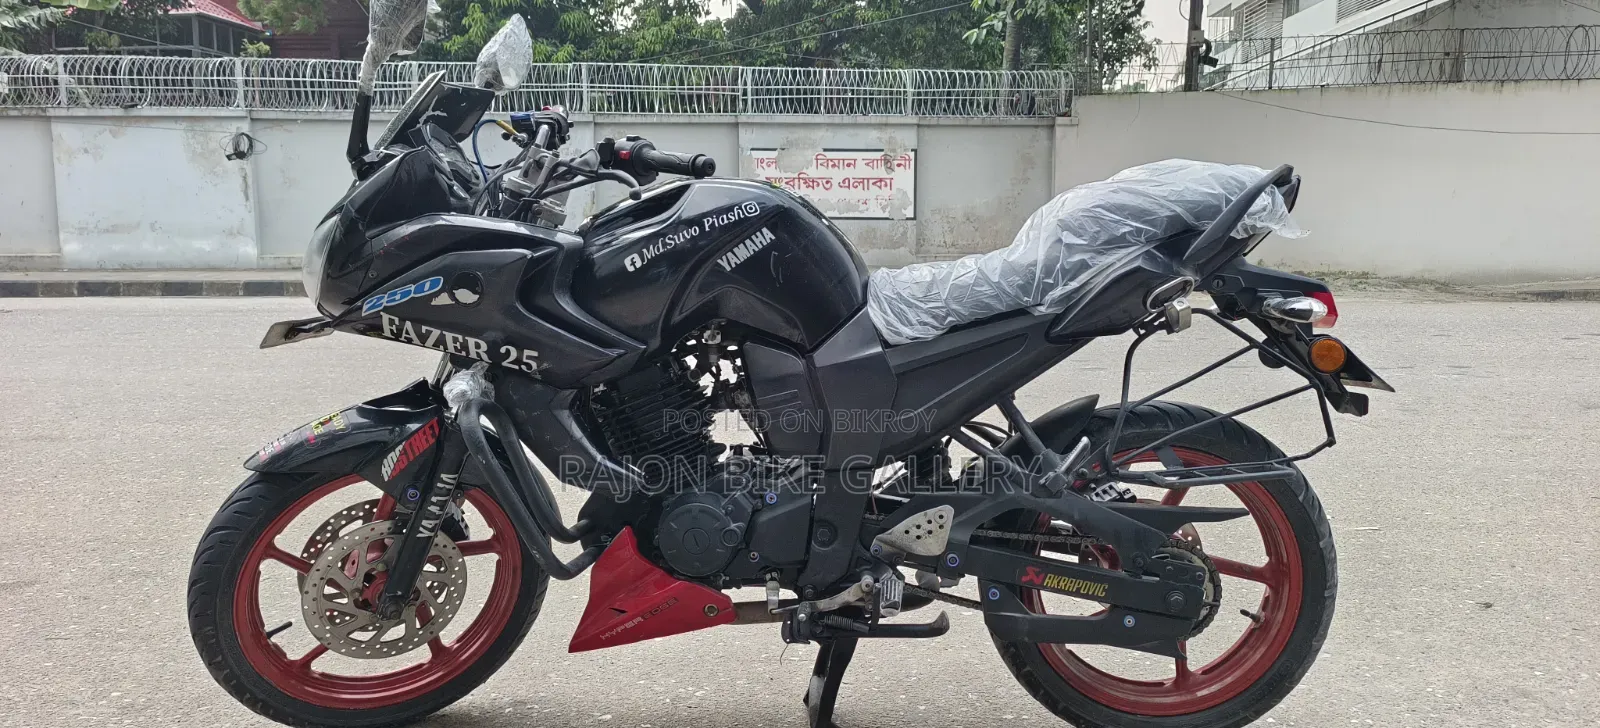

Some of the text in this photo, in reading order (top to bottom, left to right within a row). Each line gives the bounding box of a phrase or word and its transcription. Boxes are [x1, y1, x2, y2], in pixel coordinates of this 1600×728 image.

[814, 153, 857, 170] বিমান
[838, 176, 893, 191] এলাকা
[642, 226, 700, 265] Md.Suvo
[702, 207, 744, 232] Piash
[716, 226, 776, 272] YAMAHA
[362, 276, 443, 317] 250
[379, 311, 493, 364] FAZER
